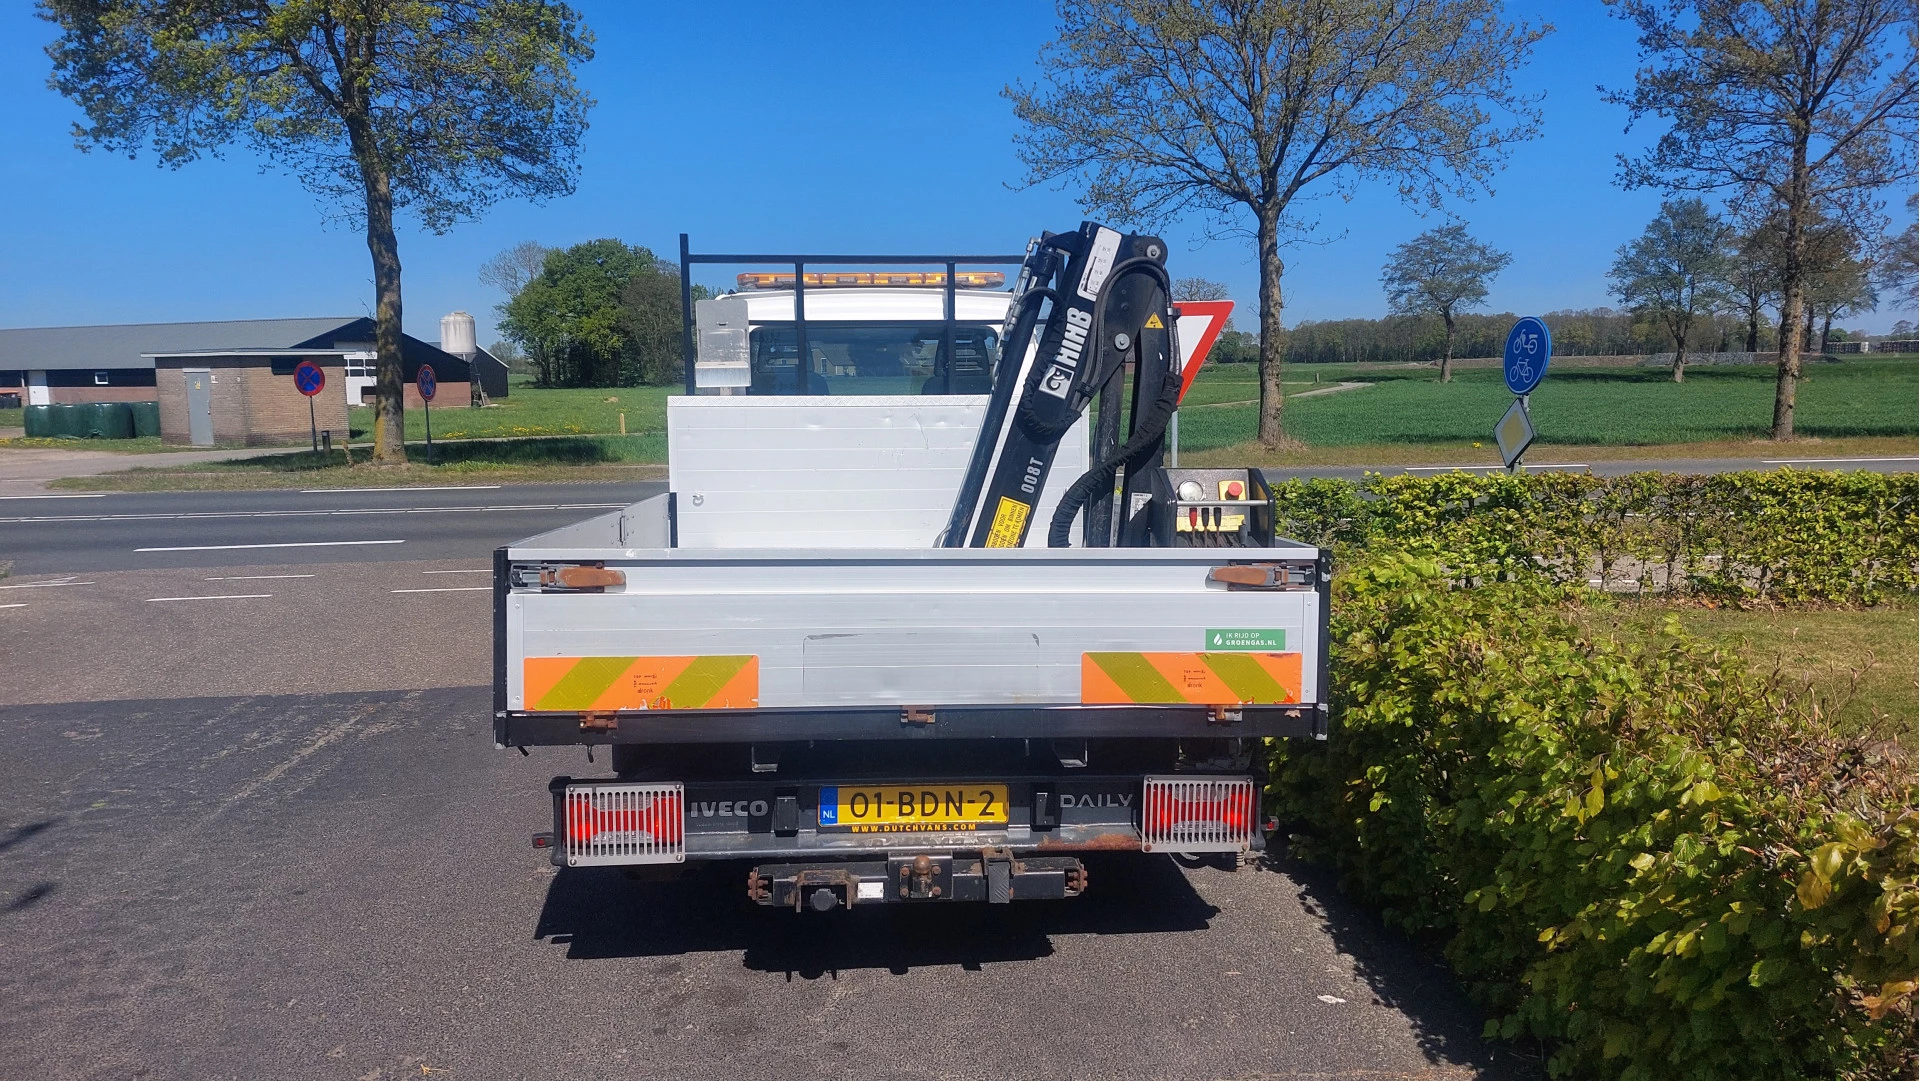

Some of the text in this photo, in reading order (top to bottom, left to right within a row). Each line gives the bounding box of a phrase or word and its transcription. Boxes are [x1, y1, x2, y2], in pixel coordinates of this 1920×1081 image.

[1021, 457, 1044, 493] 008T
[690, 800, 769, 818] IVECO
[822, 790, 995, 819] NL 01-BDN-2
[1060, 793, 1133, 808] DAILY
[851, 823, 976, 833] WWW.DUTCHVANS.COM
